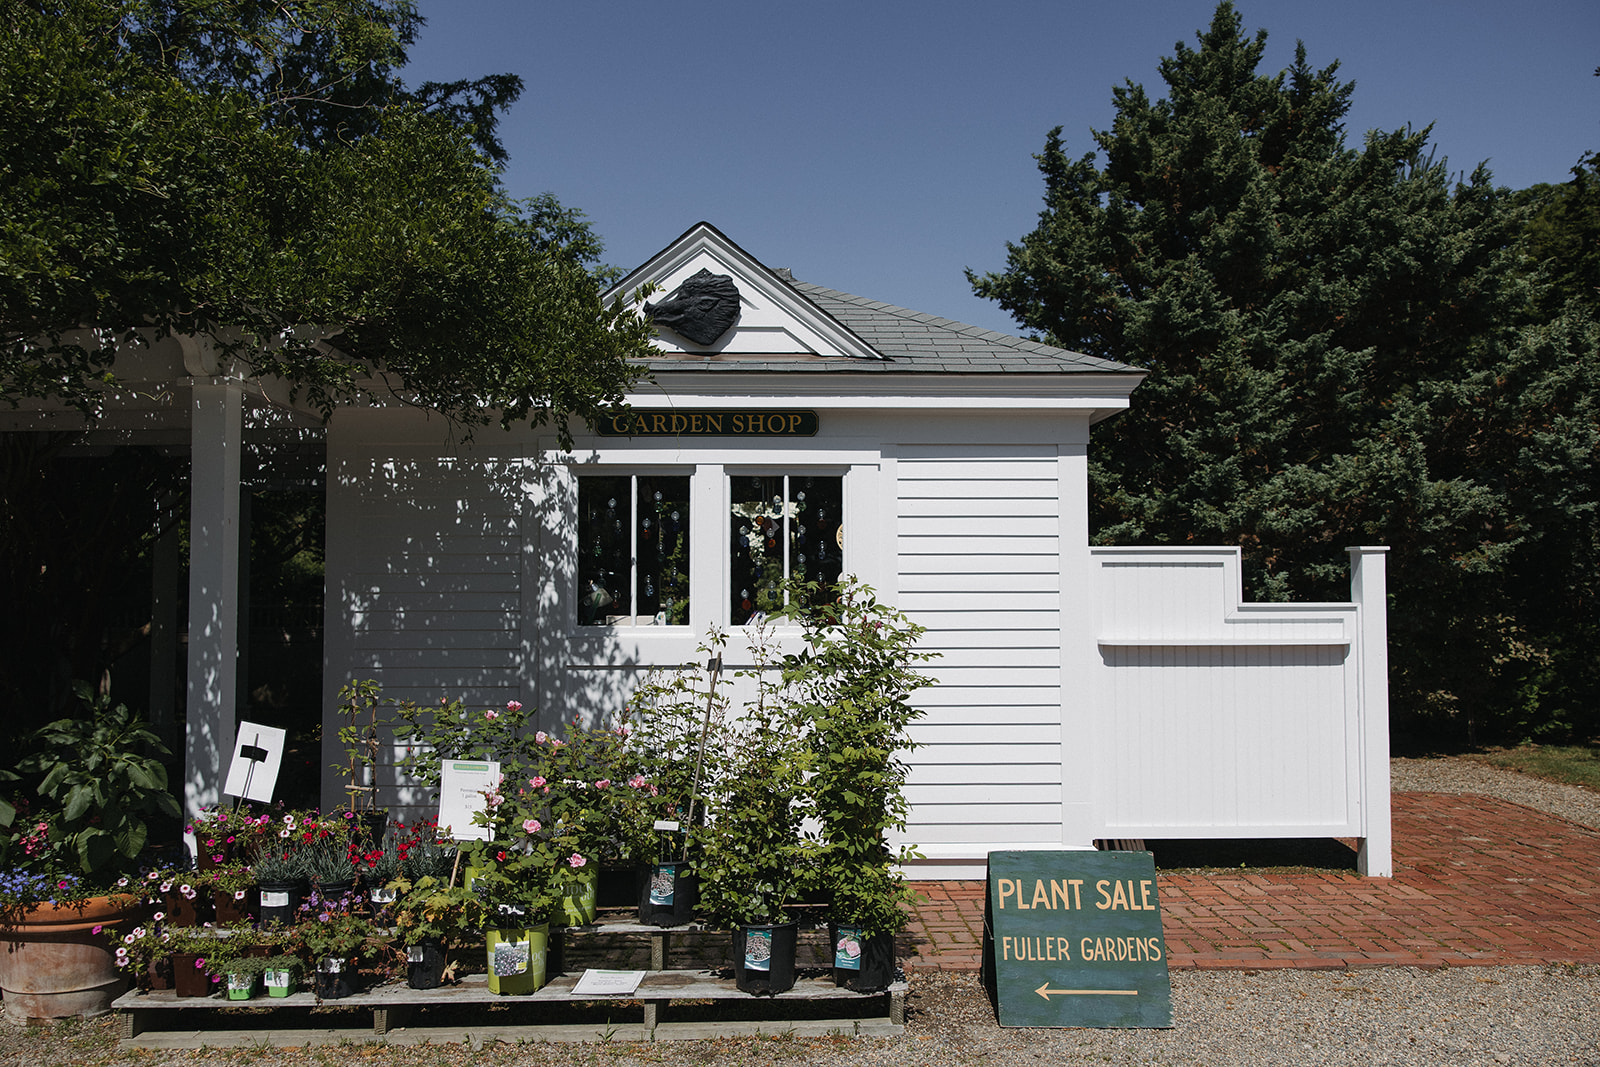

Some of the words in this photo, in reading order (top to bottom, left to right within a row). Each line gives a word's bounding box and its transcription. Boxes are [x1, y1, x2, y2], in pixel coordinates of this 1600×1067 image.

[612, 414, 723, 433] GARDEN
[732, 414, 802, 433] SHOP
[998, 879, 1083, 910] PLANT
[1095, 879, 1156, 911] SALE
[1002, 936, 1071, 961] FULLER
[1080, 937, 1162, 962] GARDENS
